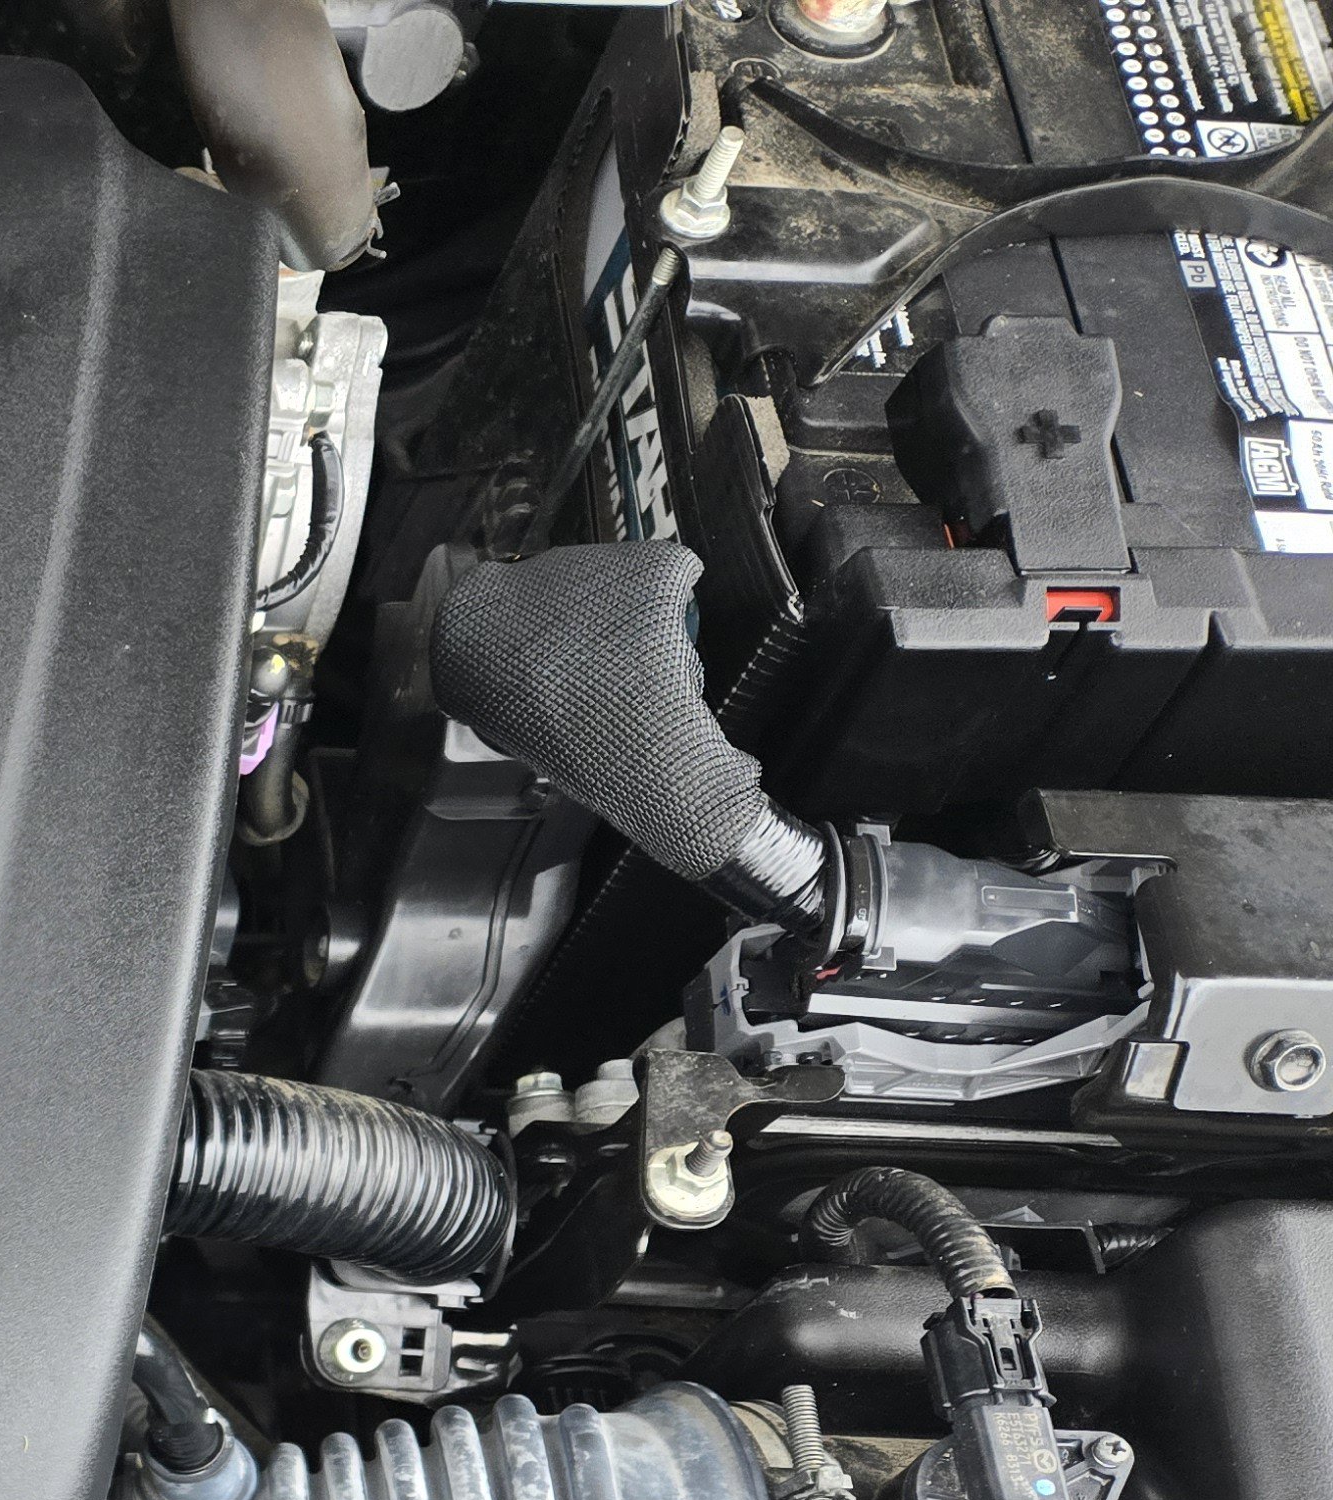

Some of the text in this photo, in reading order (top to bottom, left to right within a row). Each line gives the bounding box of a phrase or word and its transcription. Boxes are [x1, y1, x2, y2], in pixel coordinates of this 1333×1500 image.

[1187, 264, 1208, 284] Pb
[1250, 440, 1289, 491] AGM
[1007, 1412, 1032, 1466] E5T63271
